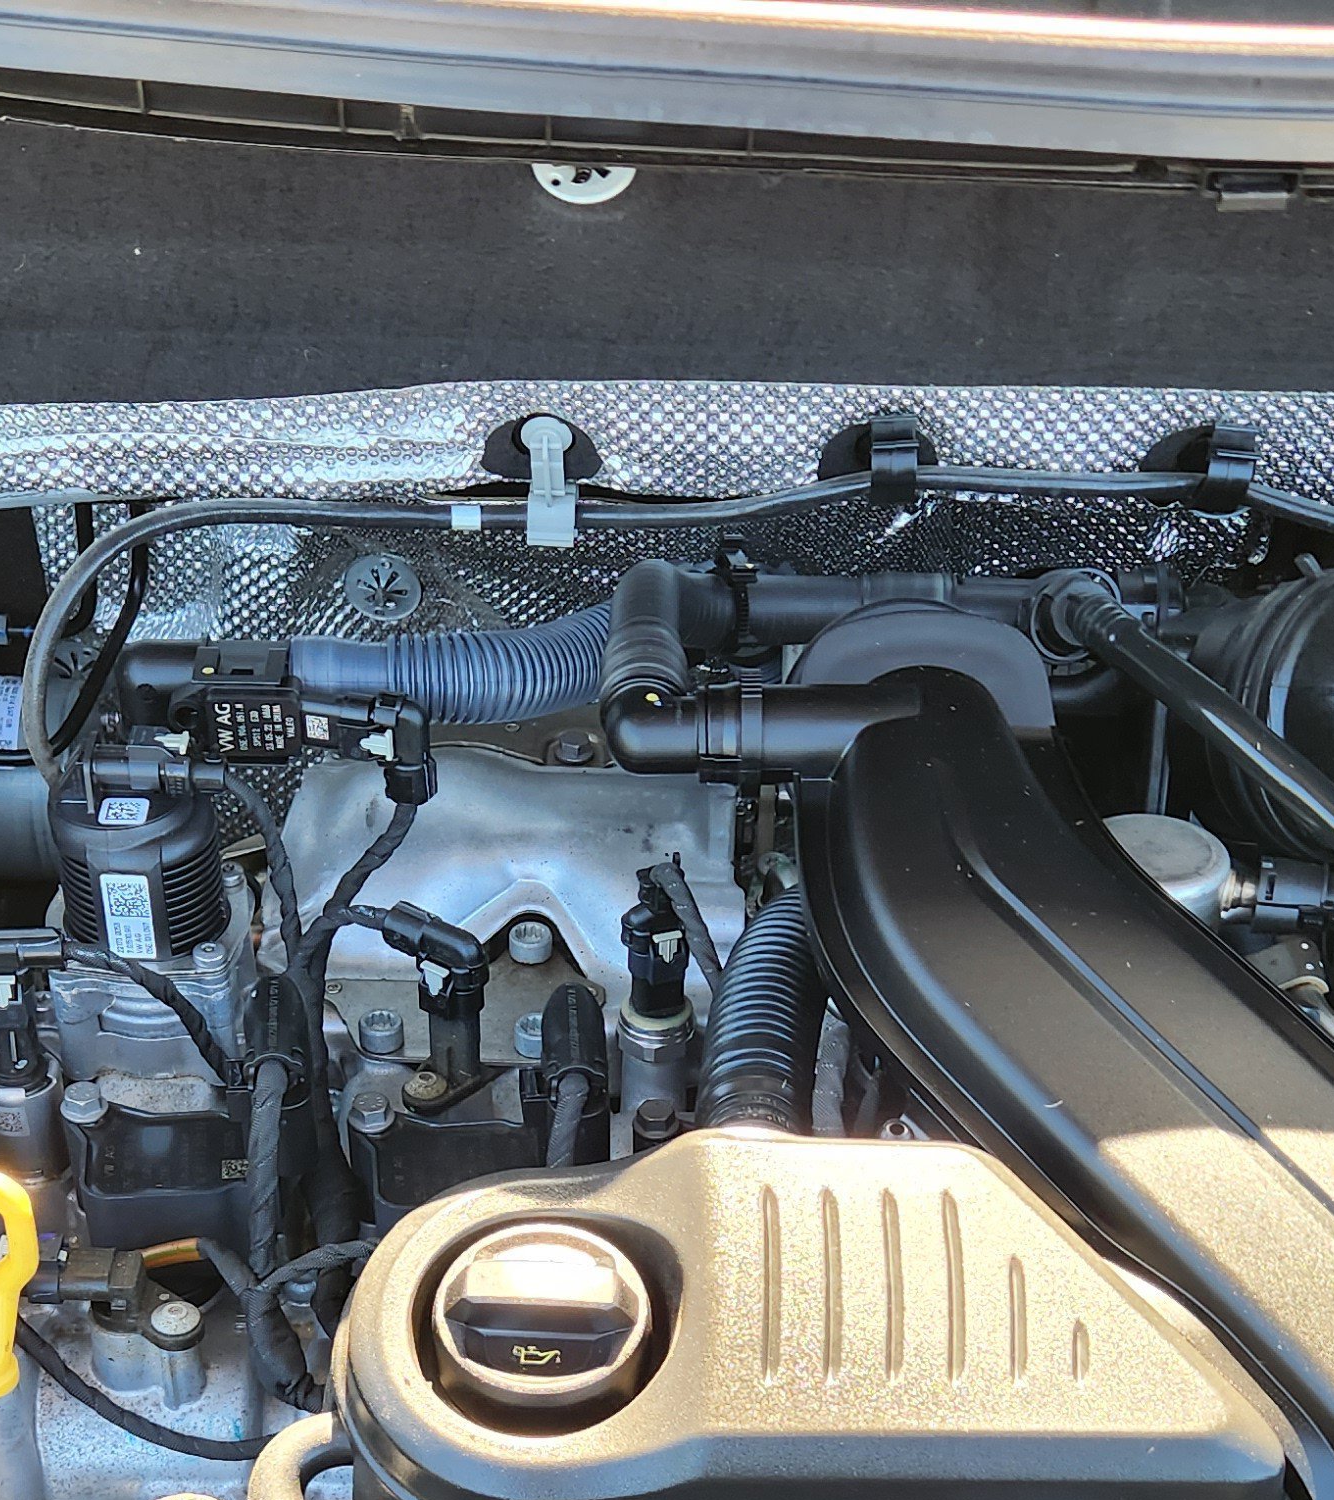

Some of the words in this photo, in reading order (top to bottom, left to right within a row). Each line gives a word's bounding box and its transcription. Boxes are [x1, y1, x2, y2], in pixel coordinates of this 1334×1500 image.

[214, 703, 233, 726] AG
[285, 717, 295, 738] VALEO
[217, 728, 235, 752] VW
